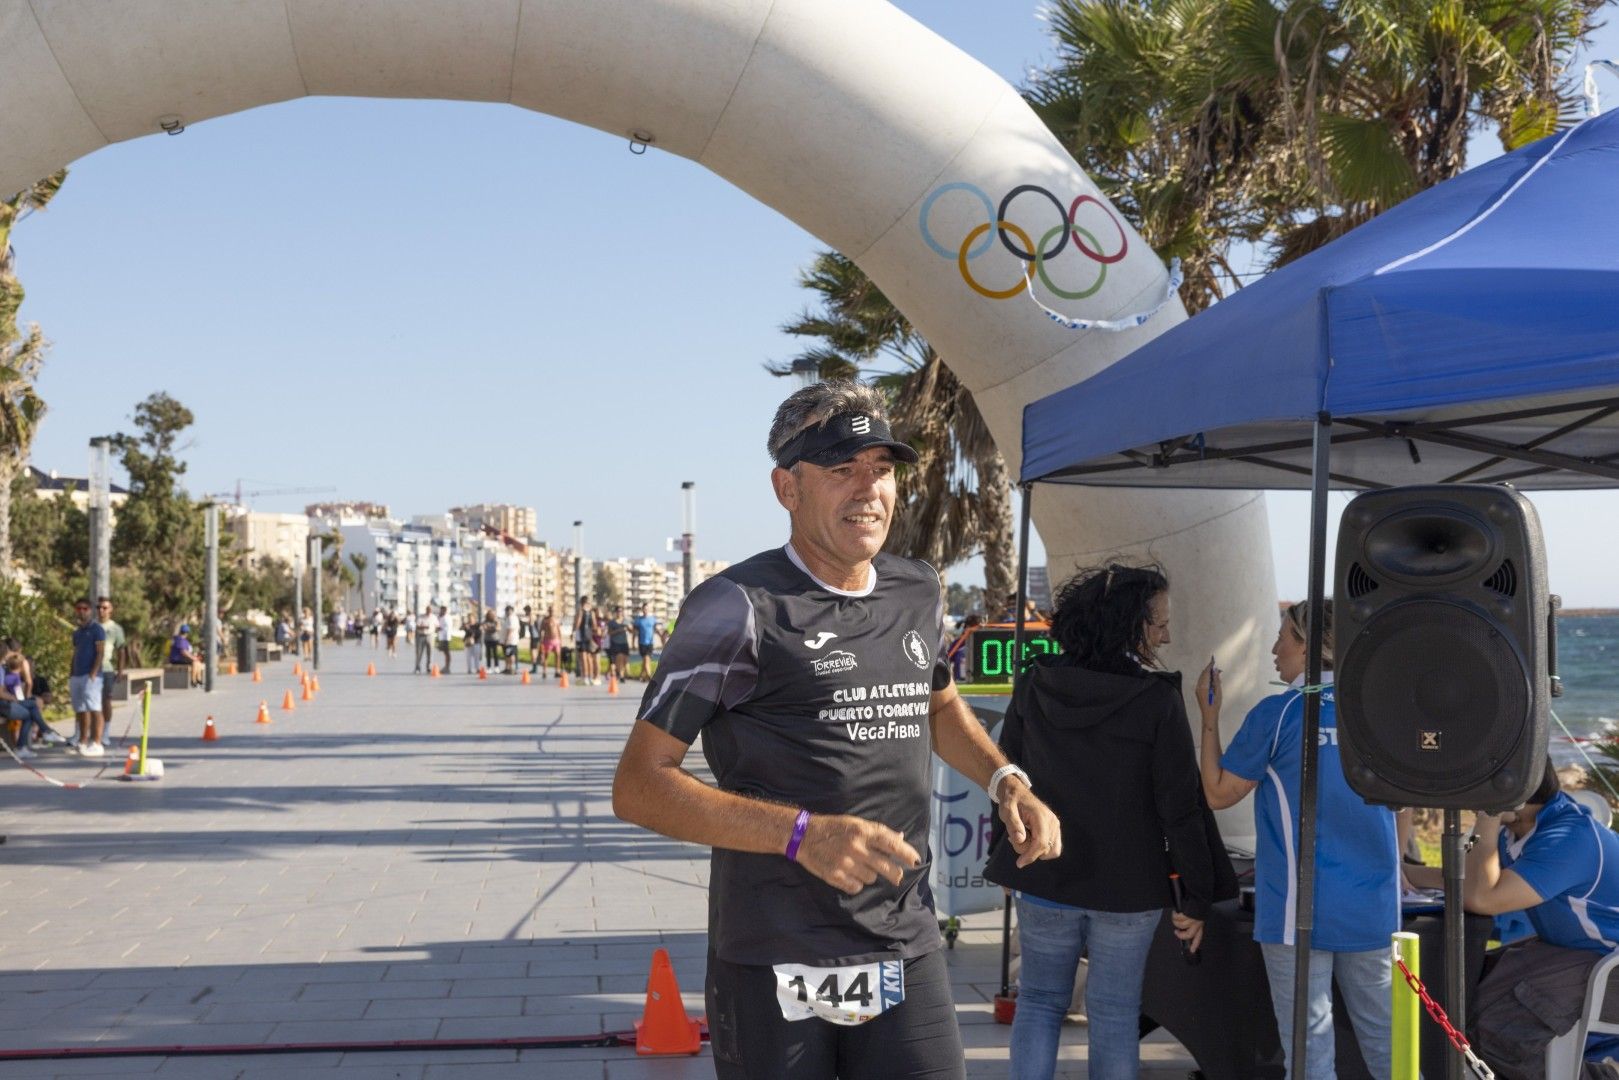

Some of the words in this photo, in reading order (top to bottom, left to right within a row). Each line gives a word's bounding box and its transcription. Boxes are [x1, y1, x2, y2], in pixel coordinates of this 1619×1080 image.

[833, 686, 867, 703] CLUB
[870, 682, 930, 699] ATLETISMO
[819, 706, 874, 721] PUERTO
[788, 971, 874, 1008] 144
[883, 960, 901, 993] KM
